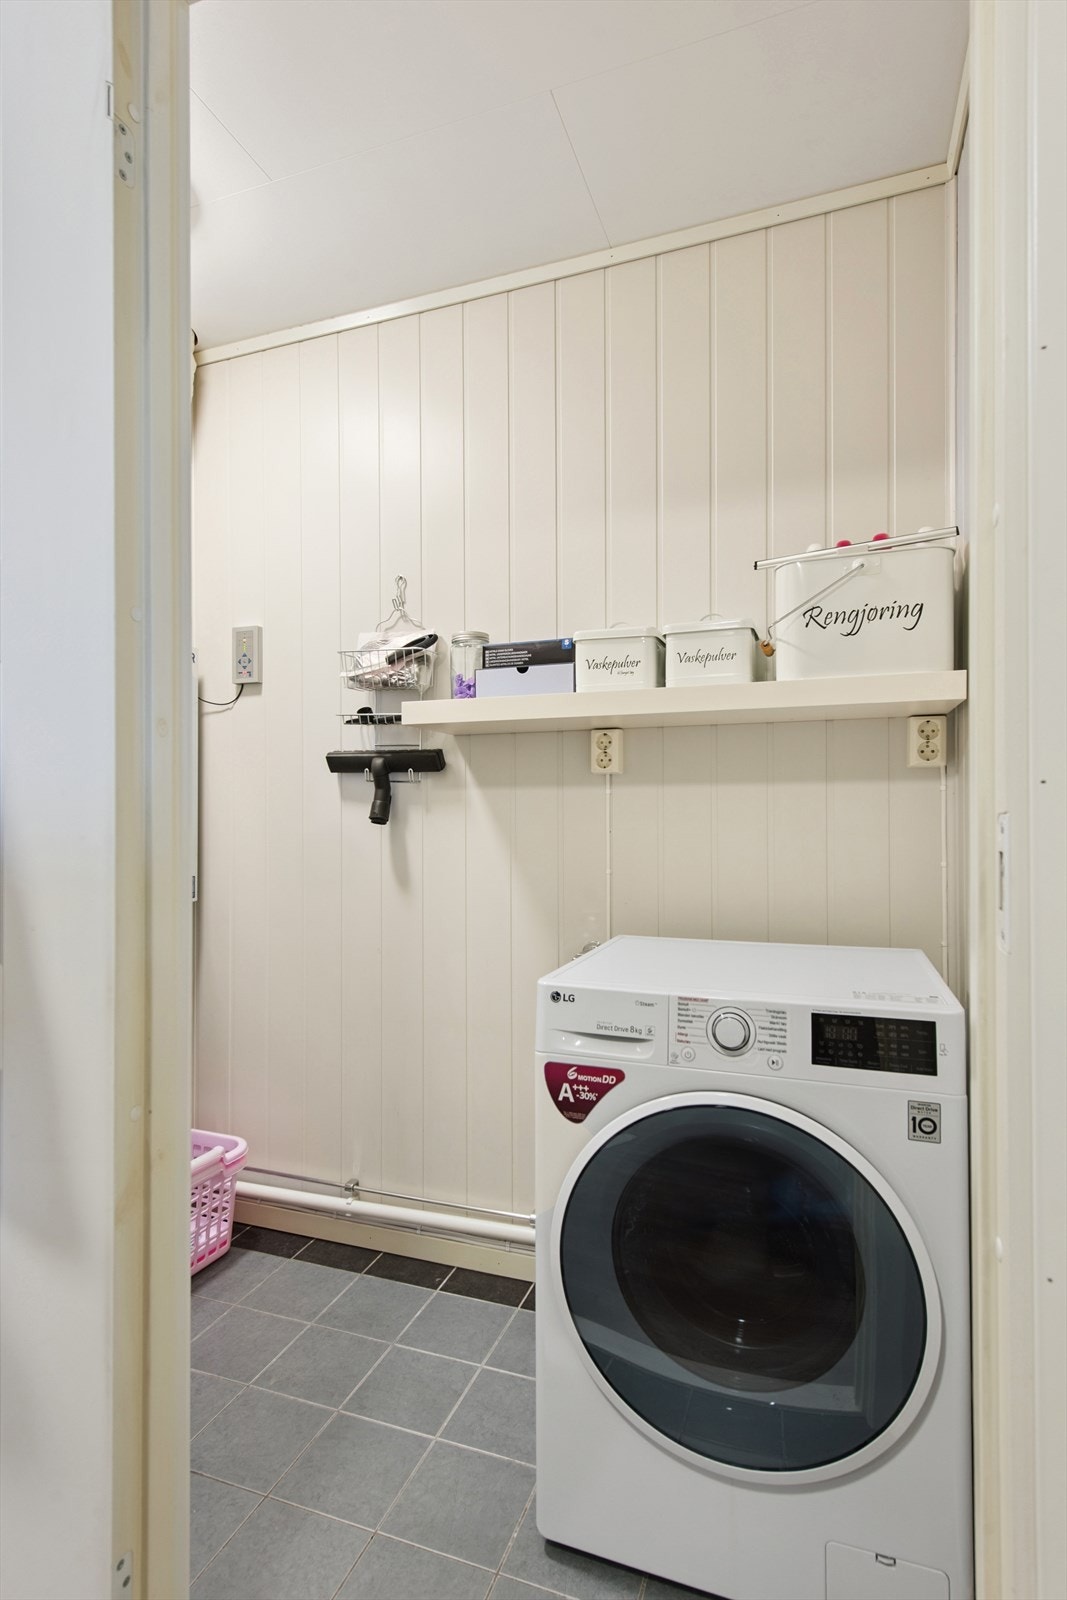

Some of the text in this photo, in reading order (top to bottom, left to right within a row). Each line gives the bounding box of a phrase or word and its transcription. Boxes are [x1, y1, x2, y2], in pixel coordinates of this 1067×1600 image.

[802, 600, 924, 637] Rengjøring
[585, 655, 641, 675] Vaskepulver
[677, 647, 737, 668] Vaskepulver
[563, 993, 575, 1003] LG
[596, 1023, 613, 1032] Direct
[614, 1024, 629, 1033] Drive
